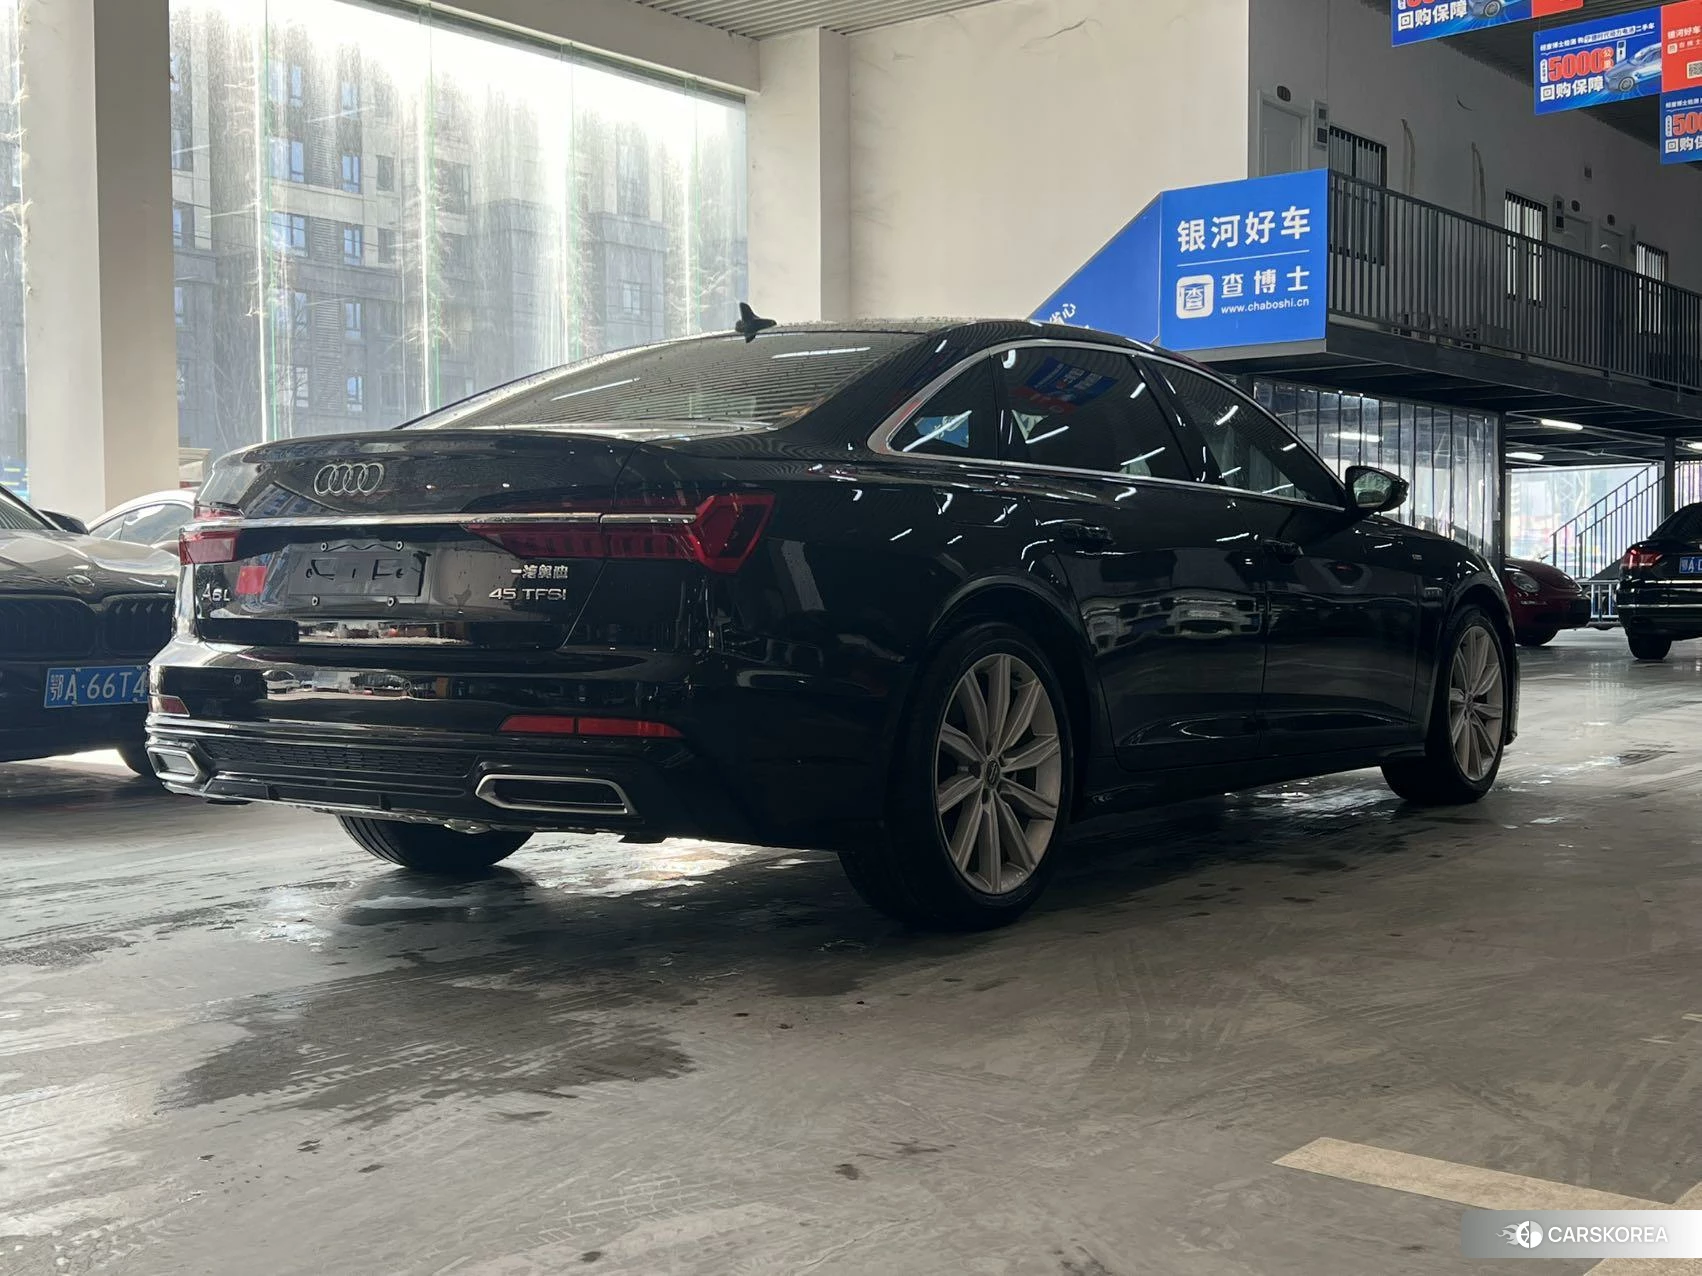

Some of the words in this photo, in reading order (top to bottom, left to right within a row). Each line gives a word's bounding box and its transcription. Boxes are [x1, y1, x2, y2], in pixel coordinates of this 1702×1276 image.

[1397, 1, 1467, 31] 回购保障
[1540, 76, 1604, 102] 回购保障
[1177, 205, 1311, 253] 银河好车
[1221, 265, 1310, 298] 查博士
[1221, 297, 1310, 314] www.chaboshi.cn
[201, 583, 231, 603] A6L
[488, 587, 517, 600] 45
[522, 588, 567, 601] TFSI
